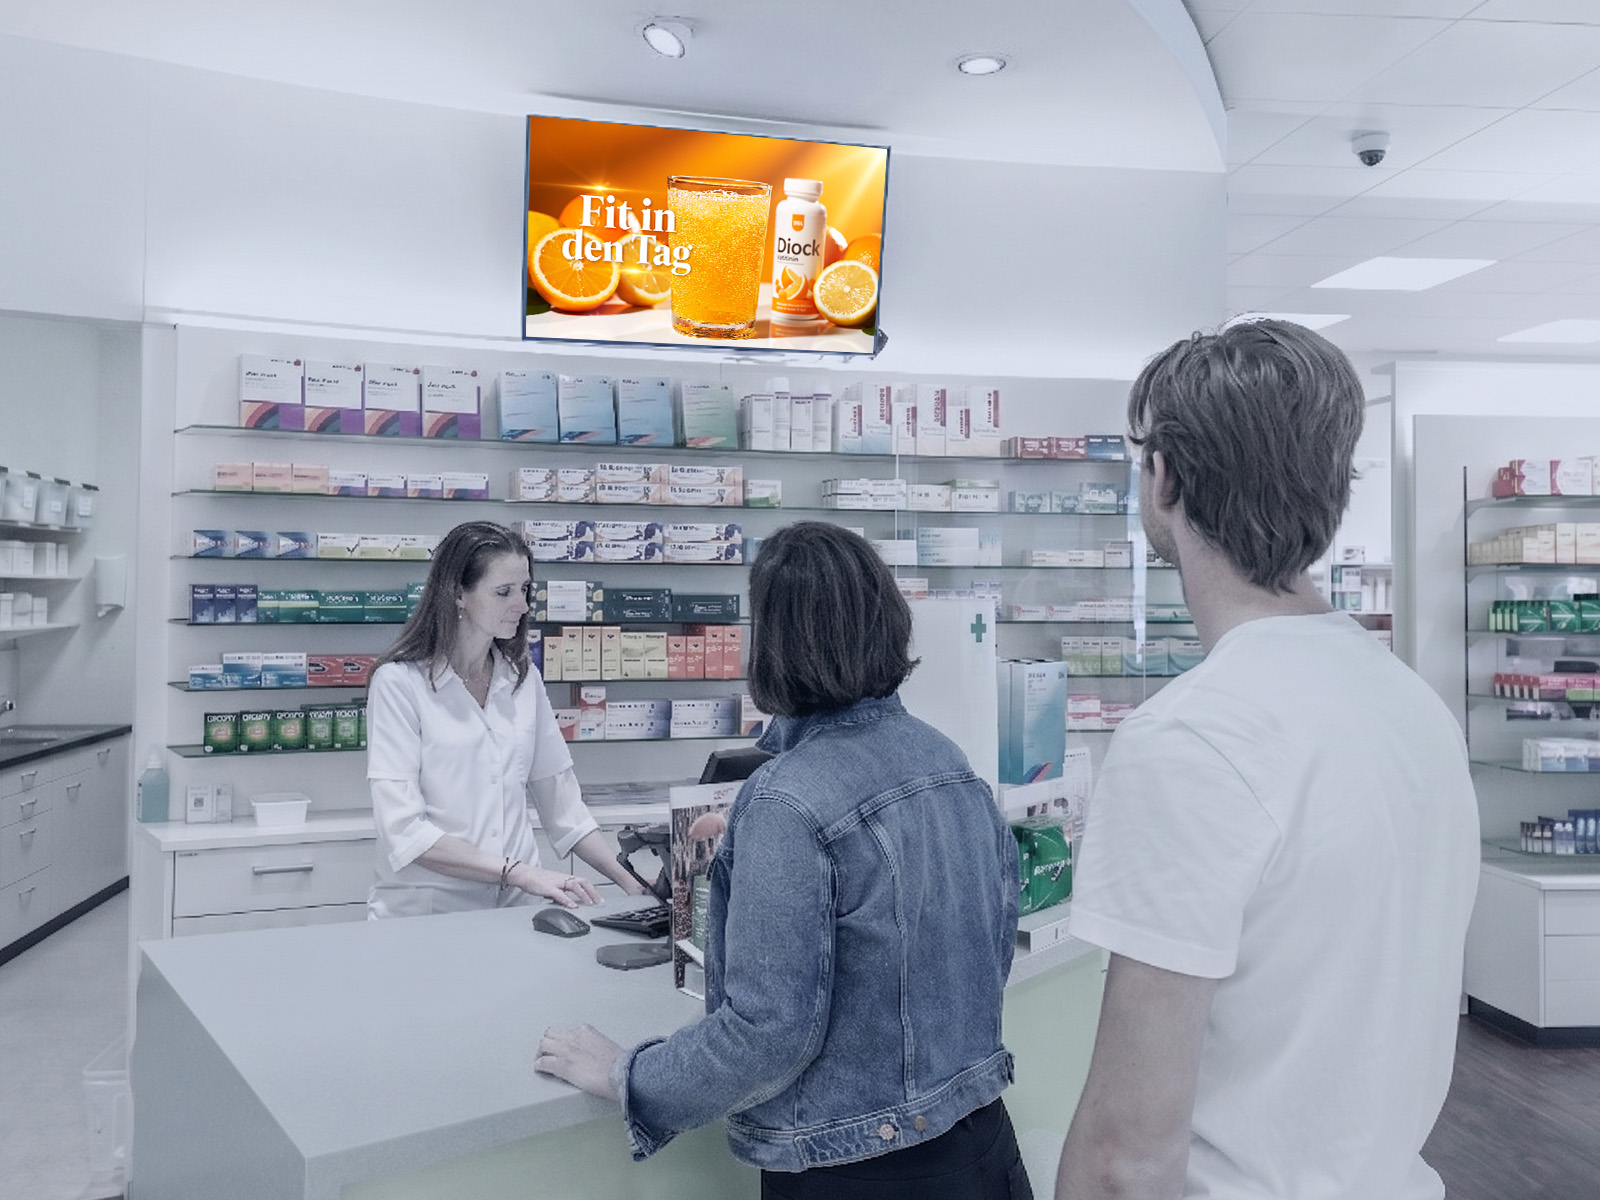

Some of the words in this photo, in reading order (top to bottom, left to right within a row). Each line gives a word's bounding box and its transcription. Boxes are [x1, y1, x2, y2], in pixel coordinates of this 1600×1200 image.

[580, 195, 632, 230] Fit
[640, 198, 676, 233] in
[562, 228, 624, 263] den
[631, 234, 693, 276] Tag
[778, 237, 820, 256] Diock
